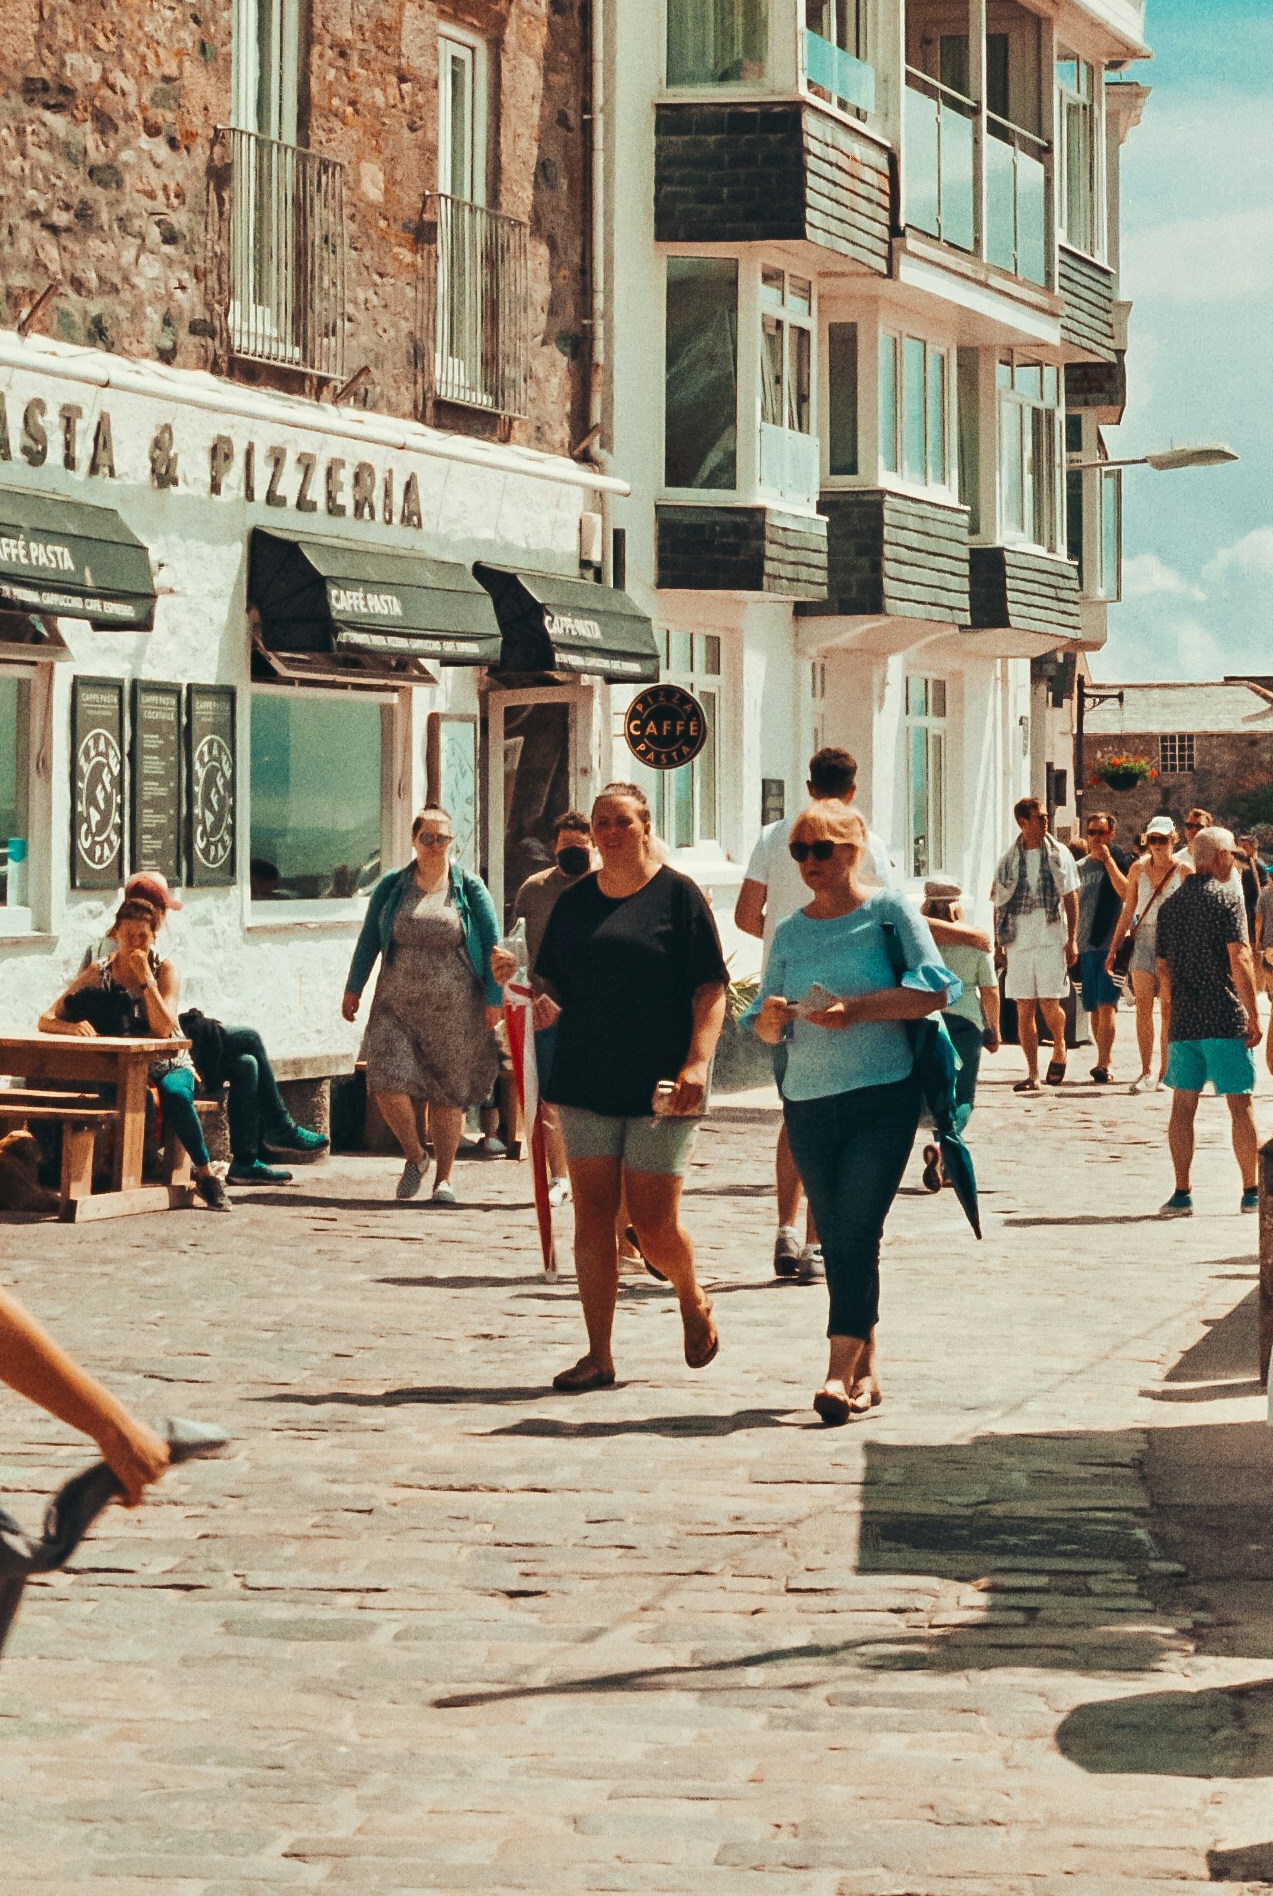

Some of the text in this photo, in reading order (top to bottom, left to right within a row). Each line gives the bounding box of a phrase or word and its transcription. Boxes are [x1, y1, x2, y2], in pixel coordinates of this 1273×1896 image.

[150, 422, 179, 489] &
[210, 434, 423, 529] PIZZERIA
[30, 542, 75, 571] PASTA
[331, 587, 402, 616] CAFFÉ PASTA
[635, 691, 693, 714] PIZZA
[629, 717, 699, 736] CAFFÉ
[635, 744, 691, 764] PASTA
